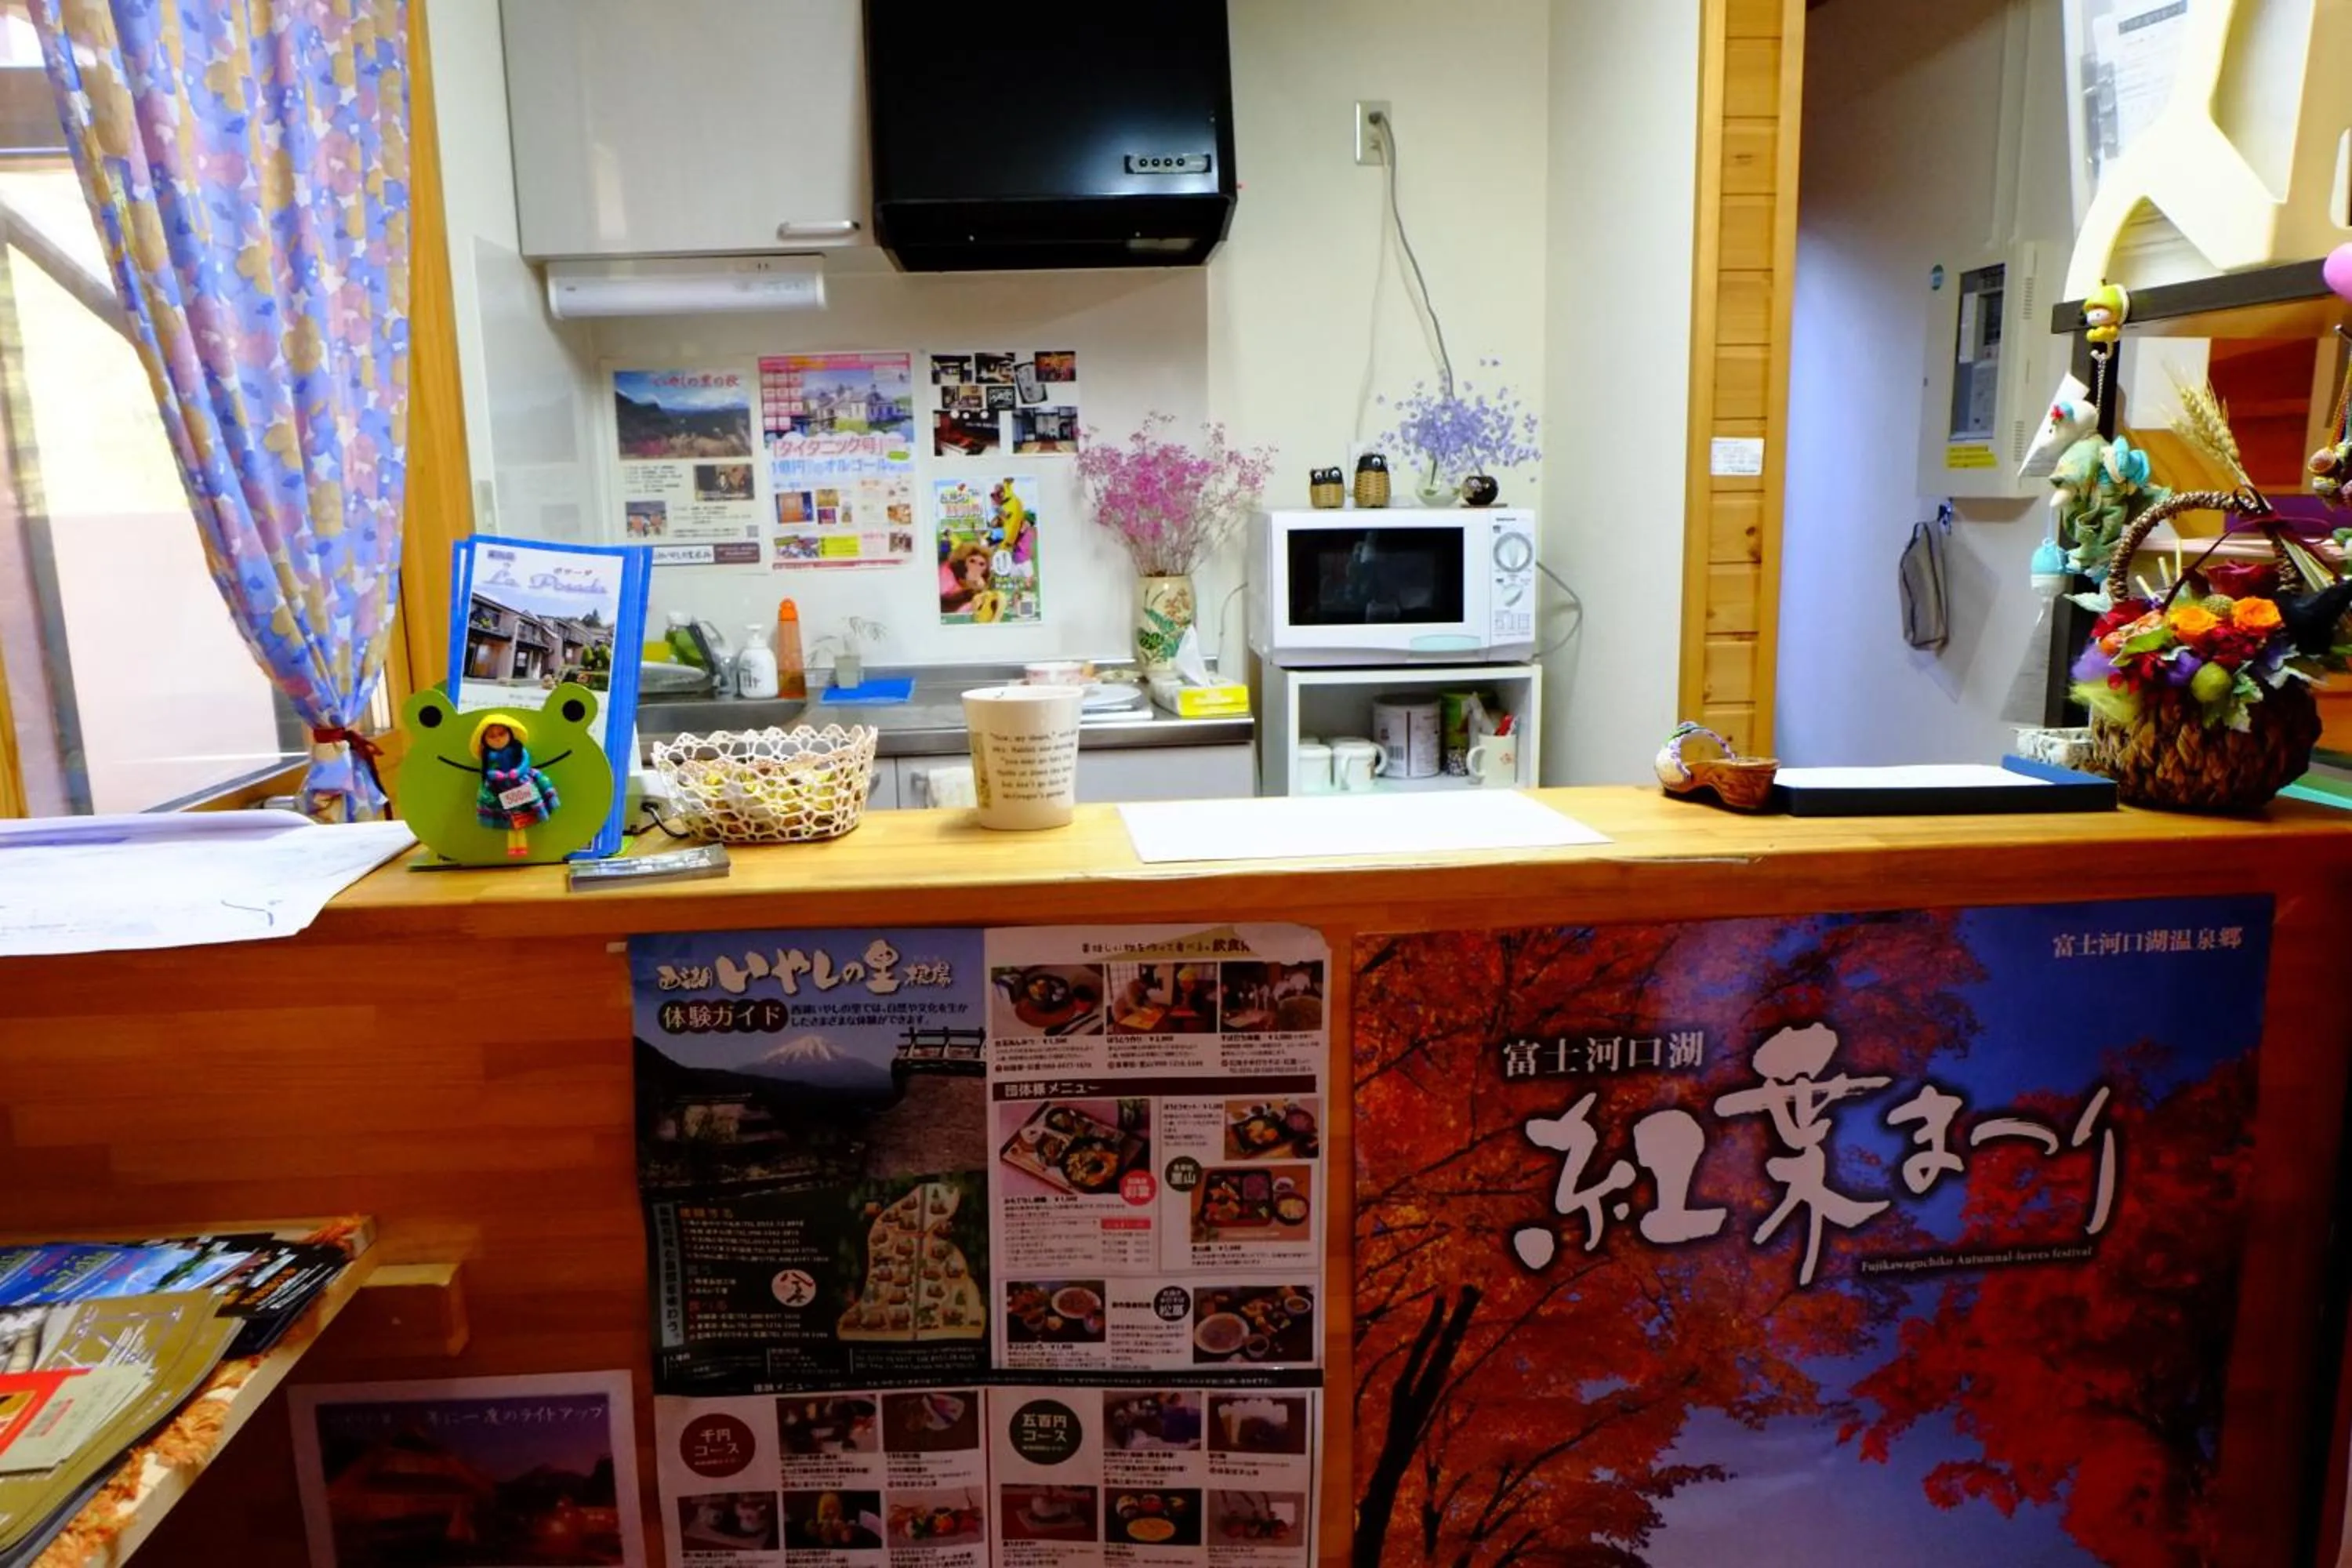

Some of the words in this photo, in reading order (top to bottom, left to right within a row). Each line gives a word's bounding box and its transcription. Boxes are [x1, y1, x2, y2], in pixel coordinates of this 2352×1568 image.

[2053, 926, 2244, 959] 富士河口湖温泉郷
[662, 1004, 782, 1029] 体験ガイド
[1502, 1030, 1705, 1079] 富士河口湖
[1004, 1081, 1102, 1098] 団体様メニュー
[1512, 1022, 2117, 1287] 紅葉まつり
[1958, 1253, 2013, 1266] Autumnal
[2016, 1247, 2049, 1261] leaves
[2052, 1245, 2093, 1259] festival
[1022, 1413, 1068, 1428] 五百円
[699, 1427, 732, 1443] 千円
[1022, 1428, 1069, 1443] コース
[694, 1443, 740, 1457] コース
